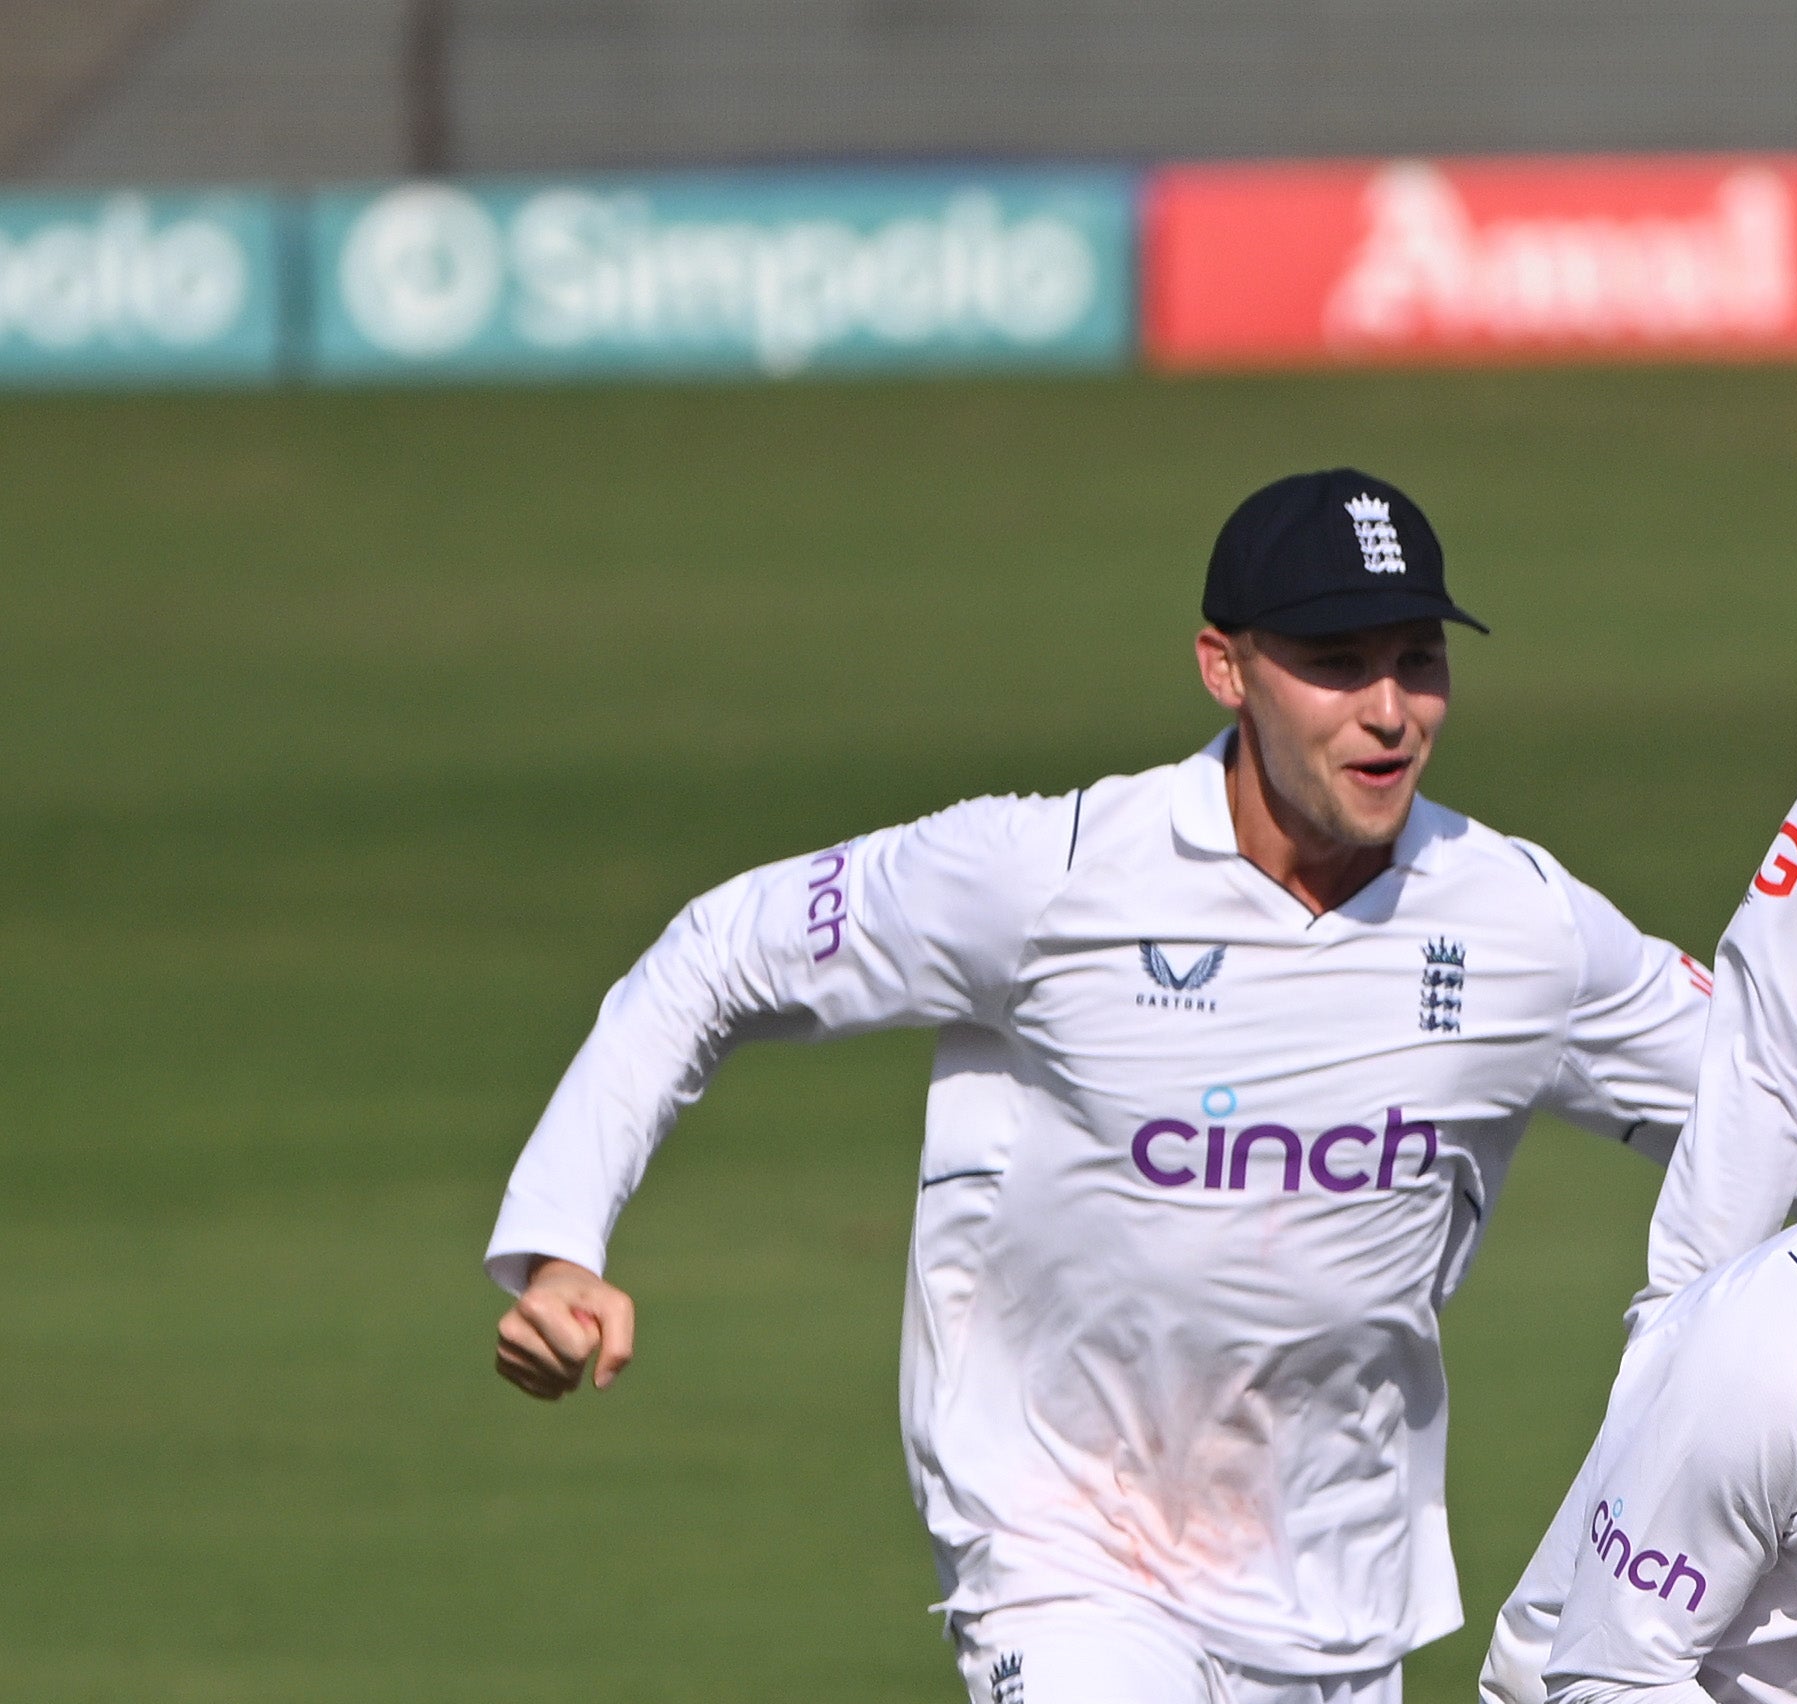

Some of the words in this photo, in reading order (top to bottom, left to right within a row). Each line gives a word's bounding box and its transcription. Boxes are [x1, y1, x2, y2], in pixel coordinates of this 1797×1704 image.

[513, 188, 1095, 377] Simpolo
[1131, 1085, 1438, 1193] cinch
[1591, 1499, 1707, 1613] cinch
